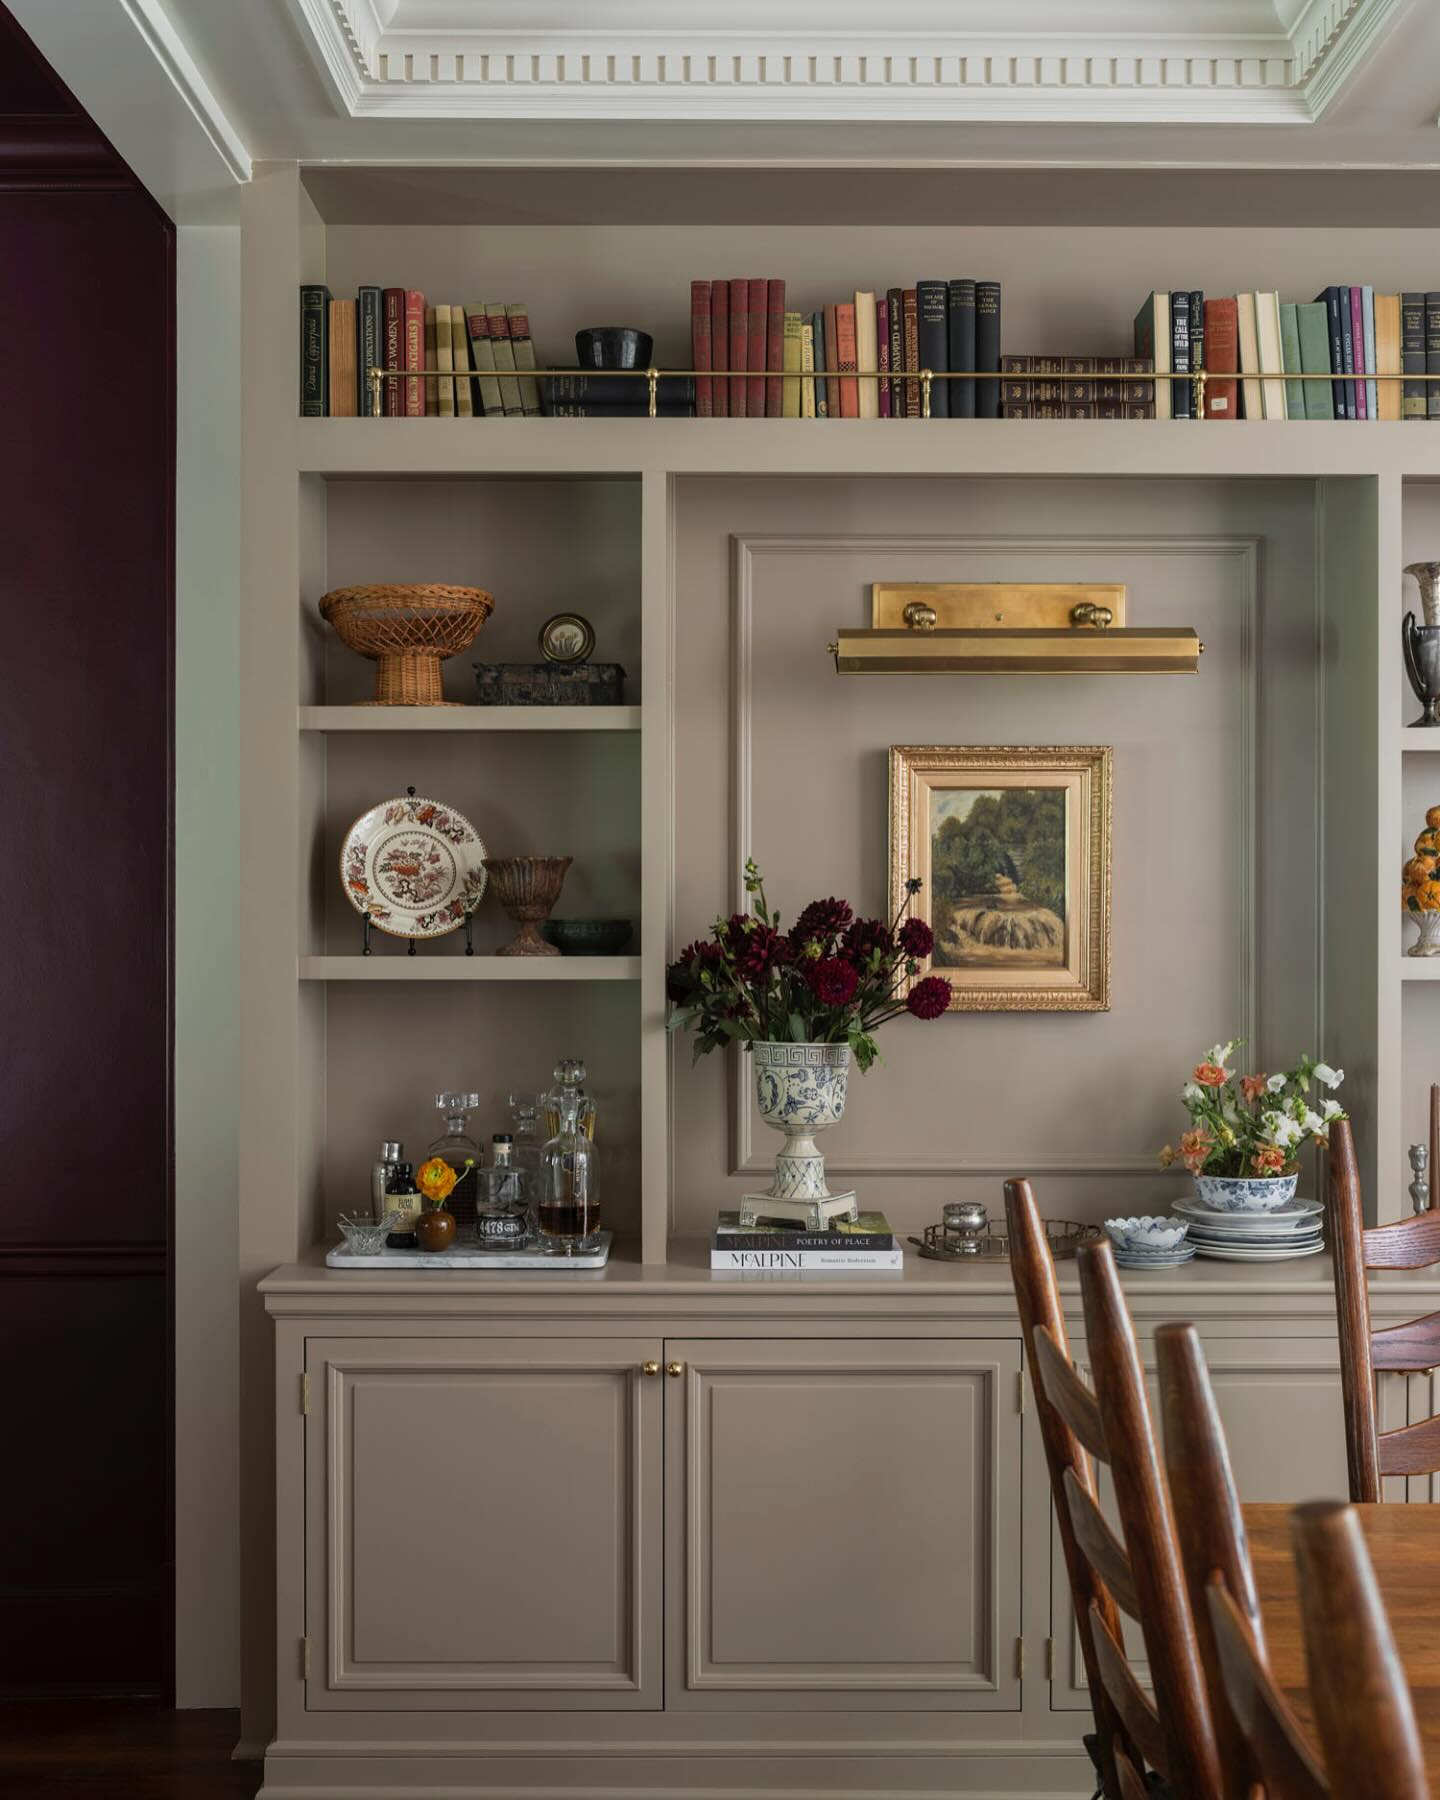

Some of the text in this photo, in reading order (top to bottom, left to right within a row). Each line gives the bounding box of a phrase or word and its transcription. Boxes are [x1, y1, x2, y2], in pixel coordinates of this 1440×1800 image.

[366, 315, 374, 367] EXPECTATIONS
[388, 320, 399, 359] WOMEN
[408, 326, 418, 362] CIGARS
[1174, 326, 1188, 334] CALL
[1344, 333, 1352, 354] CYCLES
[892, 332, 902, 385] KDNAPPED
[388, 360, 398, 390] LITLE
[480, 1220, 520, 1234] 4478 GIN
[796, 1238, 828, 1246] POETRY
[831, 1238, 842, 1246] OF
[845, 1238, 870, 1246] PLACE
